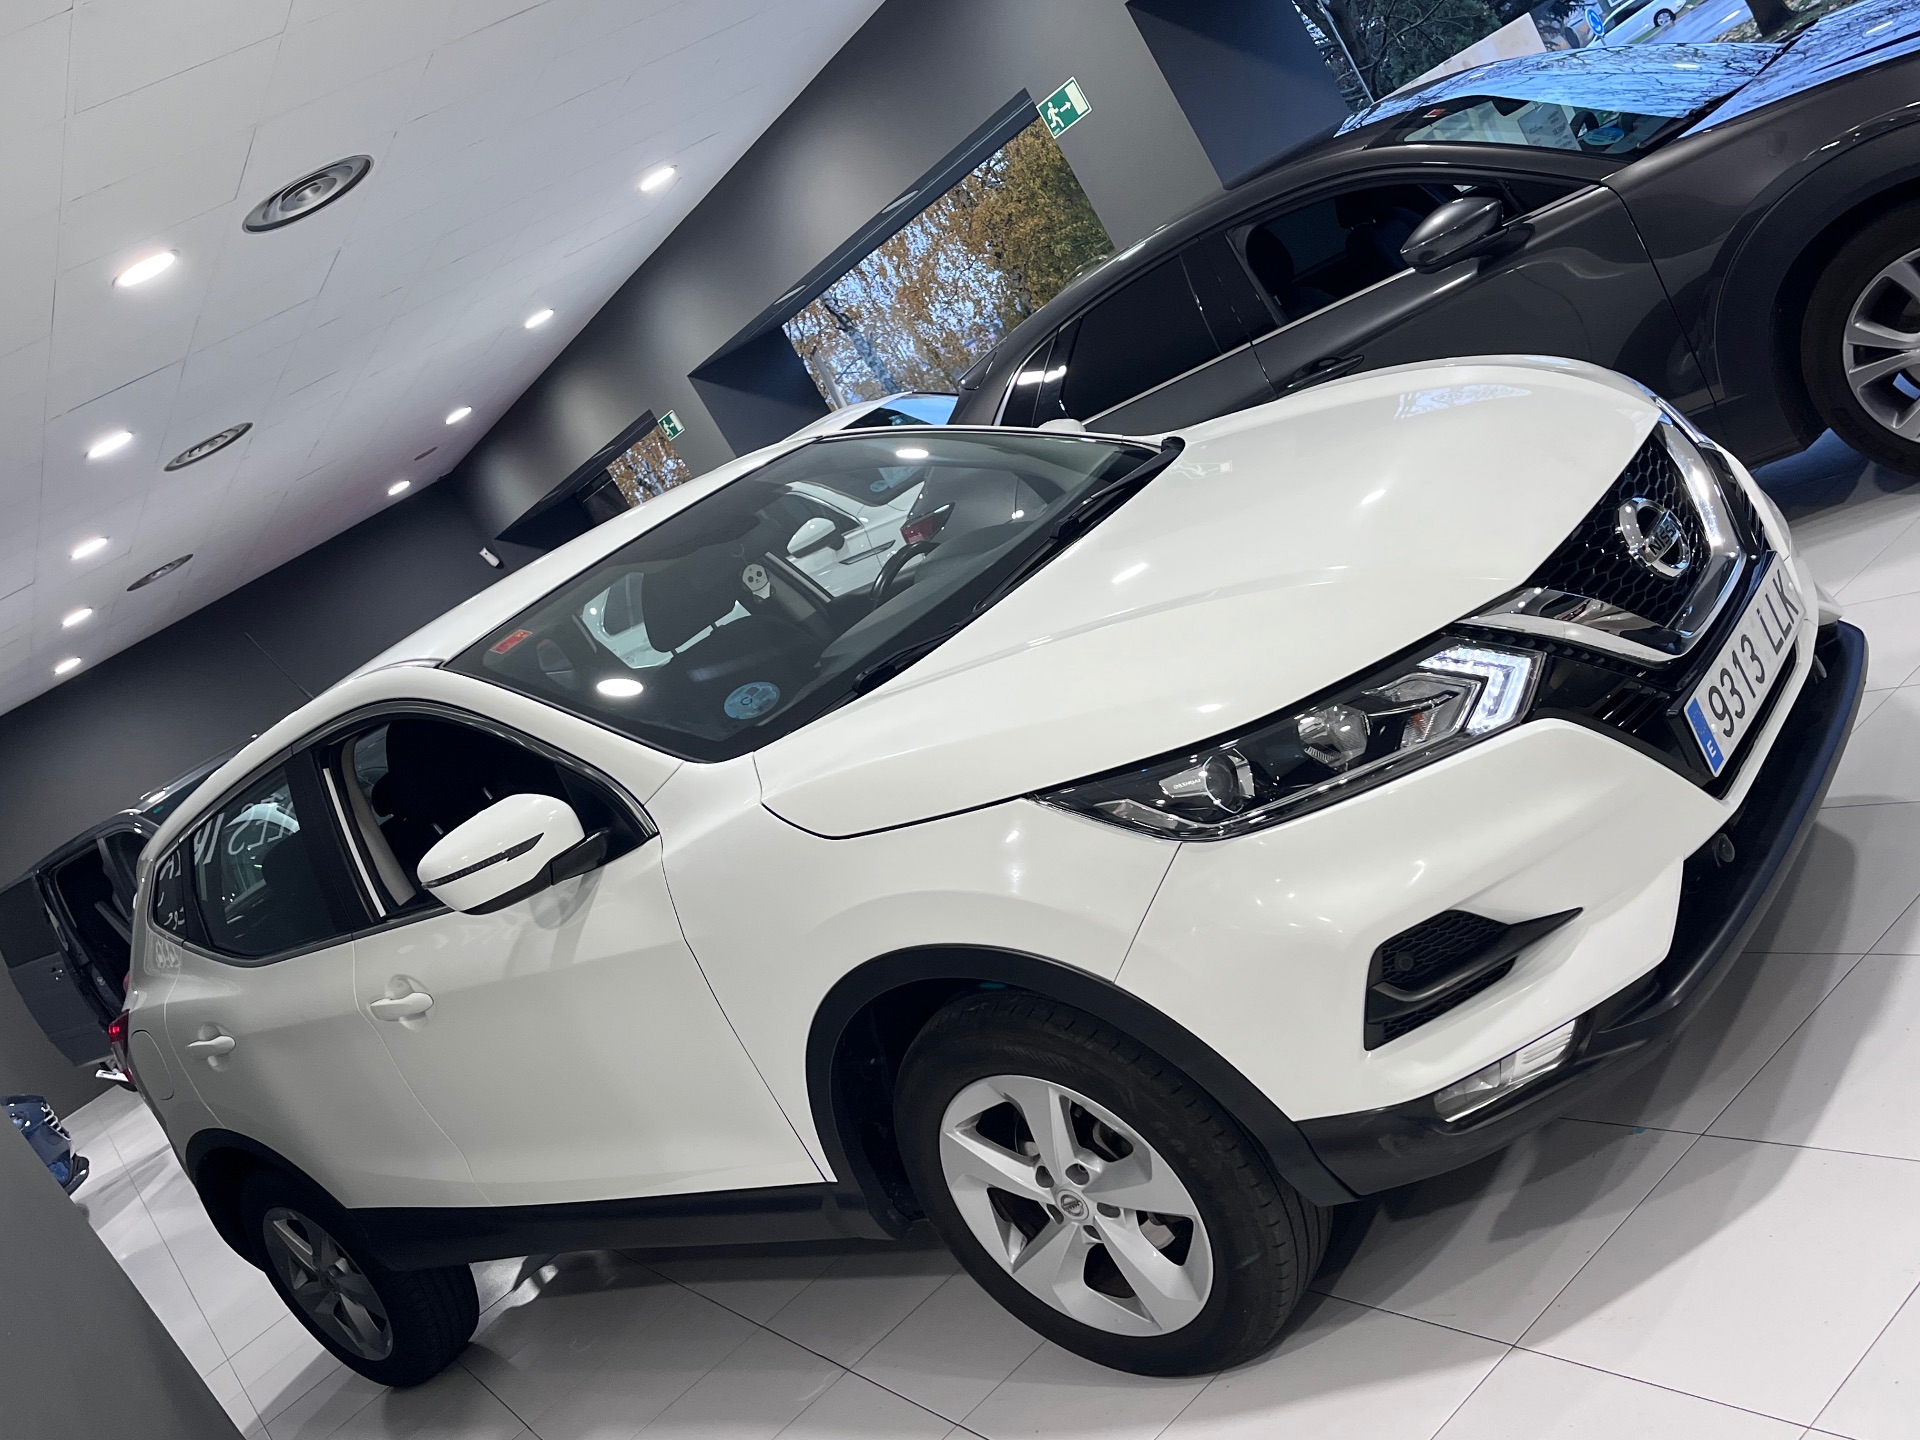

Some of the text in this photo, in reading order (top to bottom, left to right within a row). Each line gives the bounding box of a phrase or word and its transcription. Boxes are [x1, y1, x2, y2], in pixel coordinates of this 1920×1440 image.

[1648, 521, 1681, 556] NISS
[1708, 568, 1800, 738] 9313 LLK
[1706, 739, 1717, 758] E
